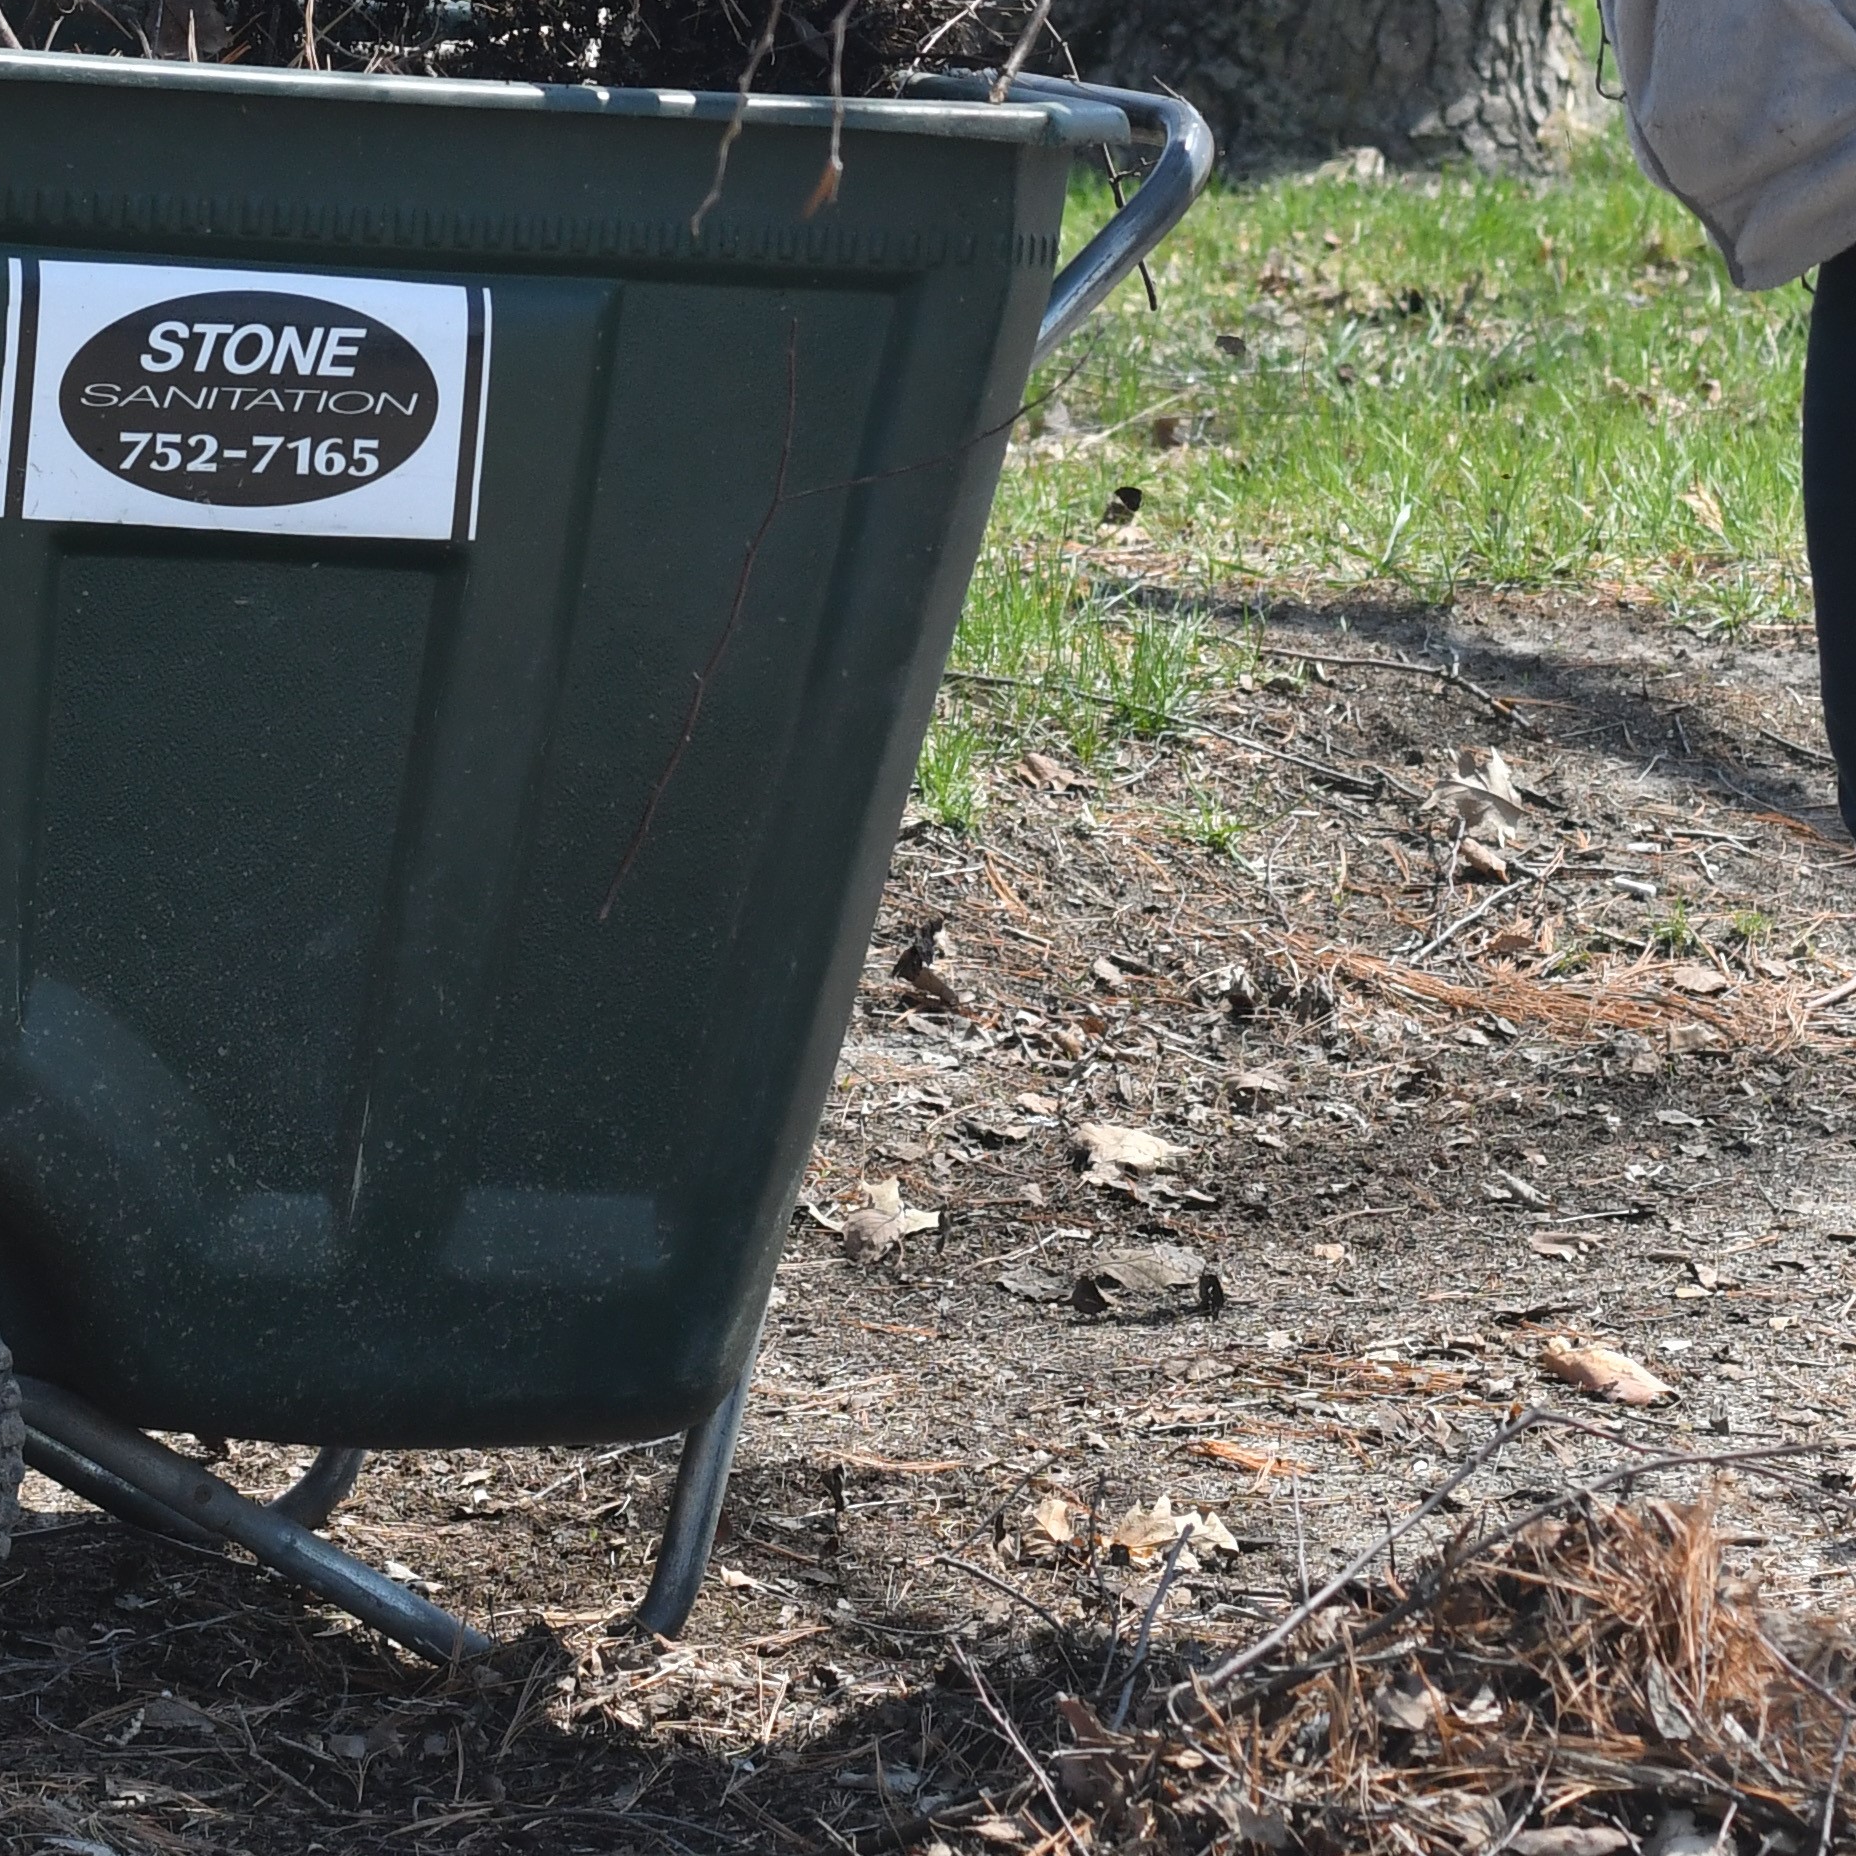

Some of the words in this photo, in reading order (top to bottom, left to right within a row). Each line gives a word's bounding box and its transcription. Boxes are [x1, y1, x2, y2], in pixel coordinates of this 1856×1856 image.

[140, 320, 368, 377] STONE
[80, 383, 419, 416] SANITATION
[119, 431, 380, 477] 752-7165
